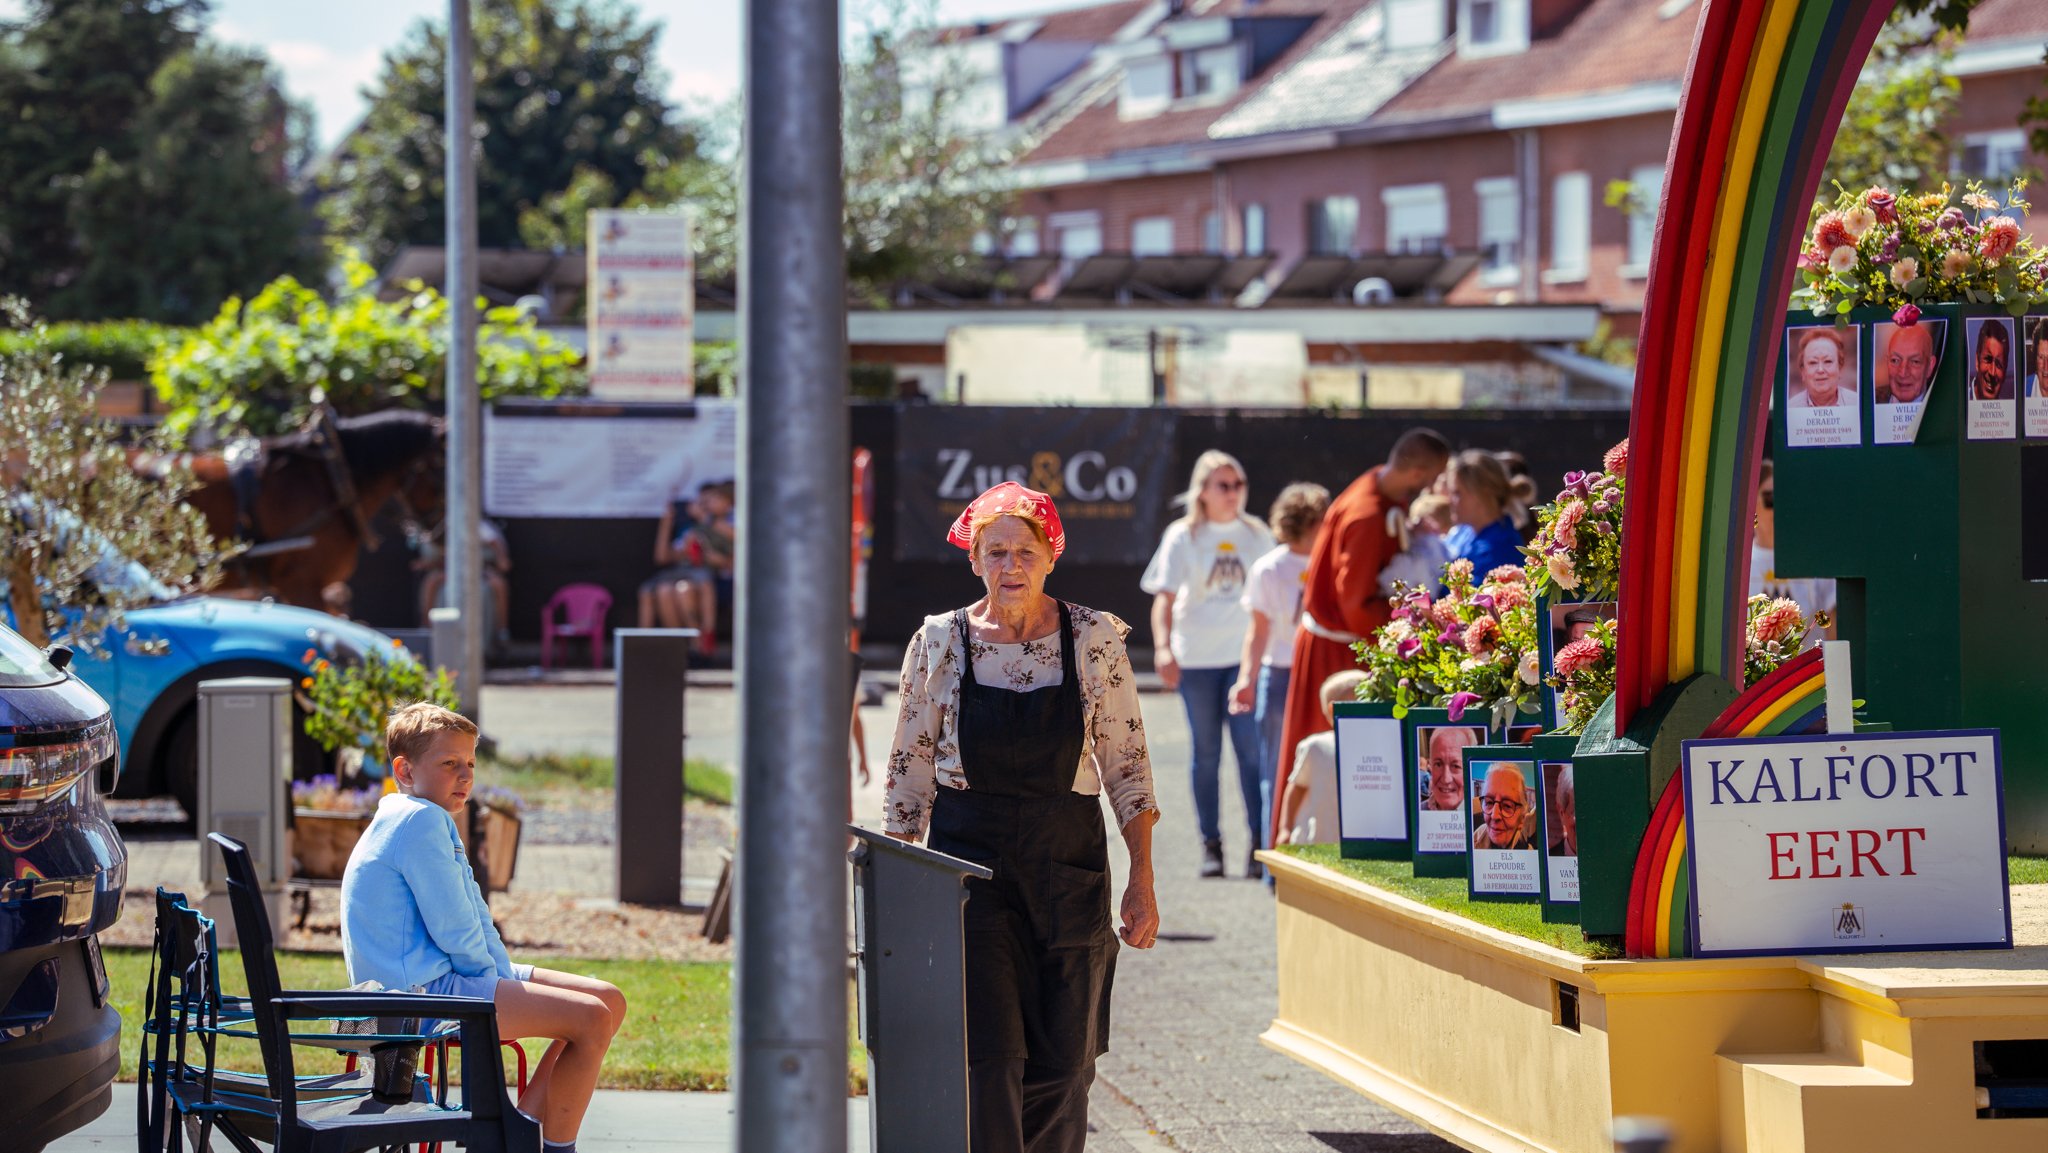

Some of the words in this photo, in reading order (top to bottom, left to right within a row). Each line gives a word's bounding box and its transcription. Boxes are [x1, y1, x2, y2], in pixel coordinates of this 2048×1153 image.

[1813, 408, 1834, 416] VERA
[936, 450, 1138, 502] Zus&Co
[1356, 764, 1388, 774] DECLERCQ
[1708, 752, 1976, 804] KALFORT
[1450, 814, 1458, 822] JO
[1501, 852, 1512, 860] ELS
[1766, 828, 1926, 880] EERT
[1490, 862, 1526, 870] LEPOUDRE
[1560, 870, 1574, 878] VAN
